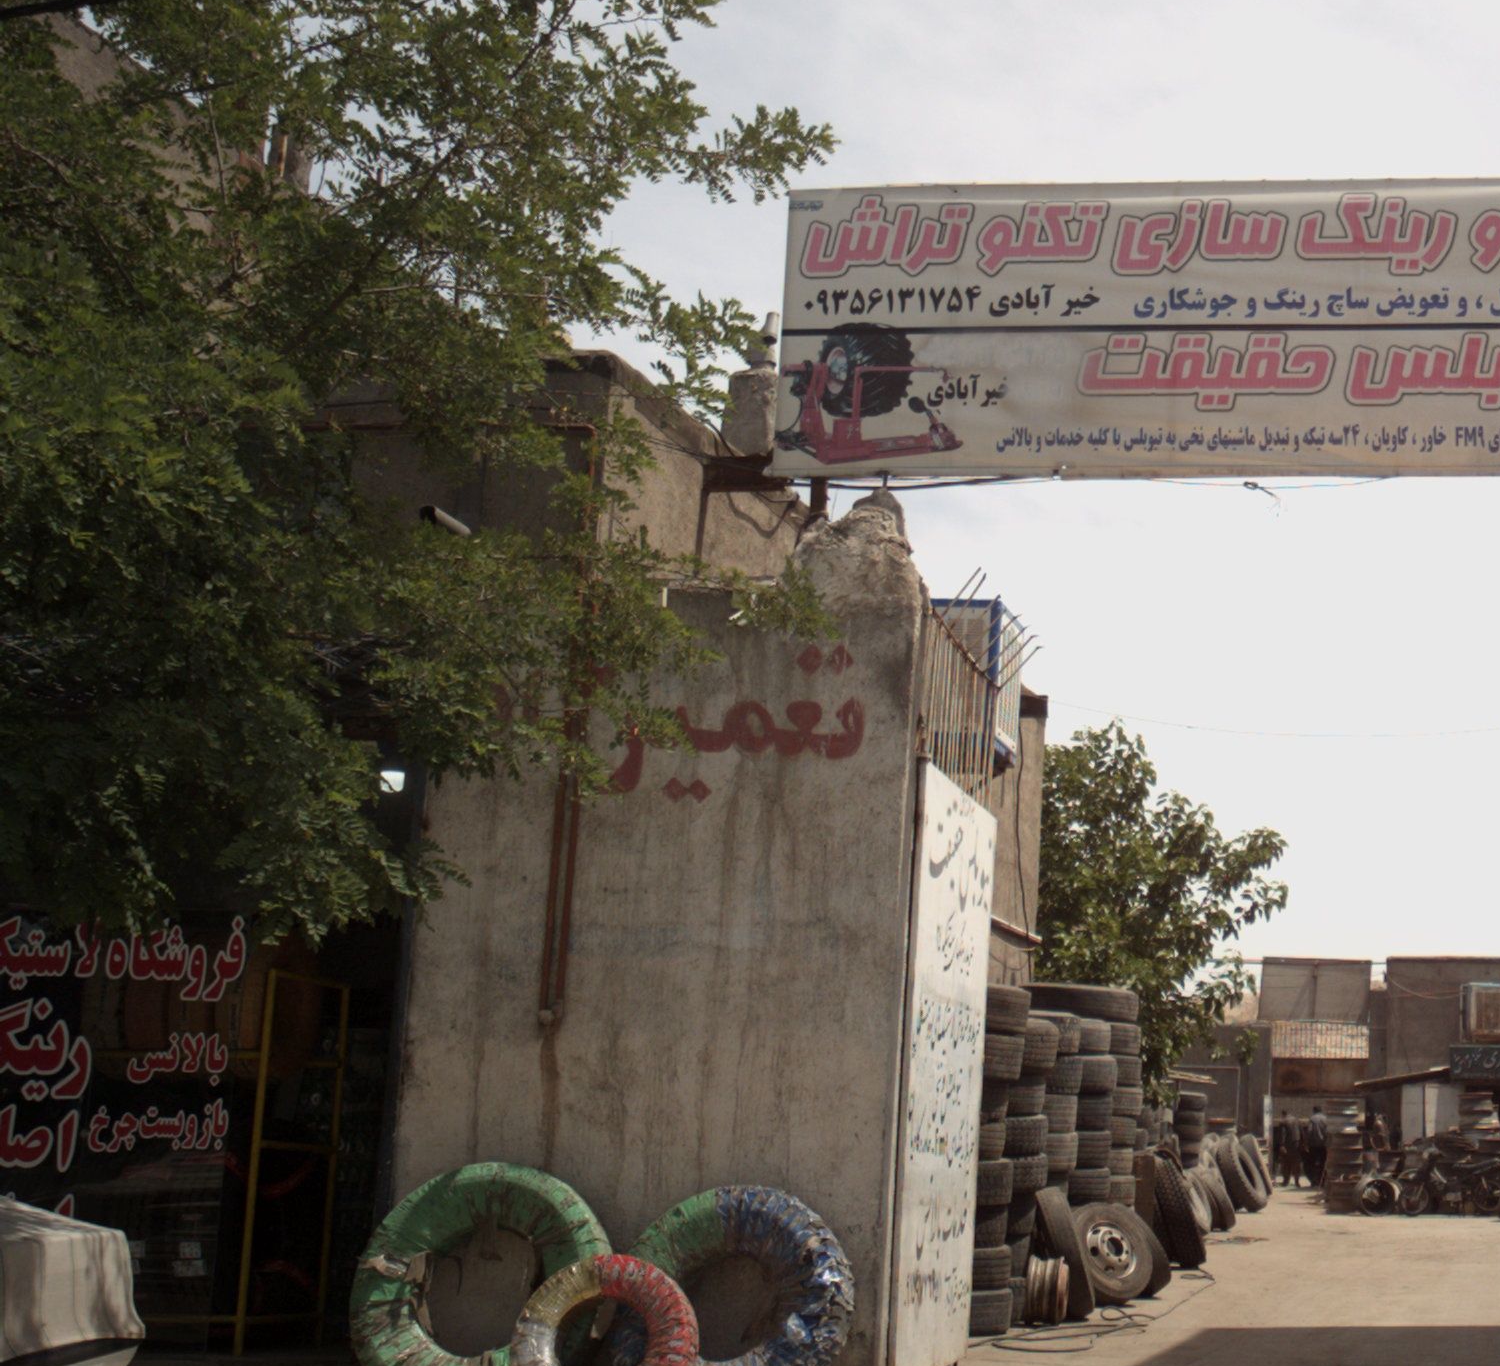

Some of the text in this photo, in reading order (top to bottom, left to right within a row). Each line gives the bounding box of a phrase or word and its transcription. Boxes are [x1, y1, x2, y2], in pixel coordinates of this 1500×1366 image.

[800, 194, 975, 279] تراش
[976, 200, 1109, 277] تکنو
[1111, 197, 1289, 277] سازی
[1296, 192, 1458, 276] رینگ
[804, 285, 982, 316] ۰۹۳۵۶۱۳۱۷۵۴
[1134, 287, 1237, 318] جوشکاری
[1244, 296, 1257, 318] و
[1263, 288, 1320, 317] رینگ
[1376, 288, 1449, 317] تعویض
[1456, 296, 1468, 317] و
[1077, 331, 1334, 412] حقیقت
[106, 915, 247, 1002] فروشگاه
[127, 1032, 229, 1087] بالانس
